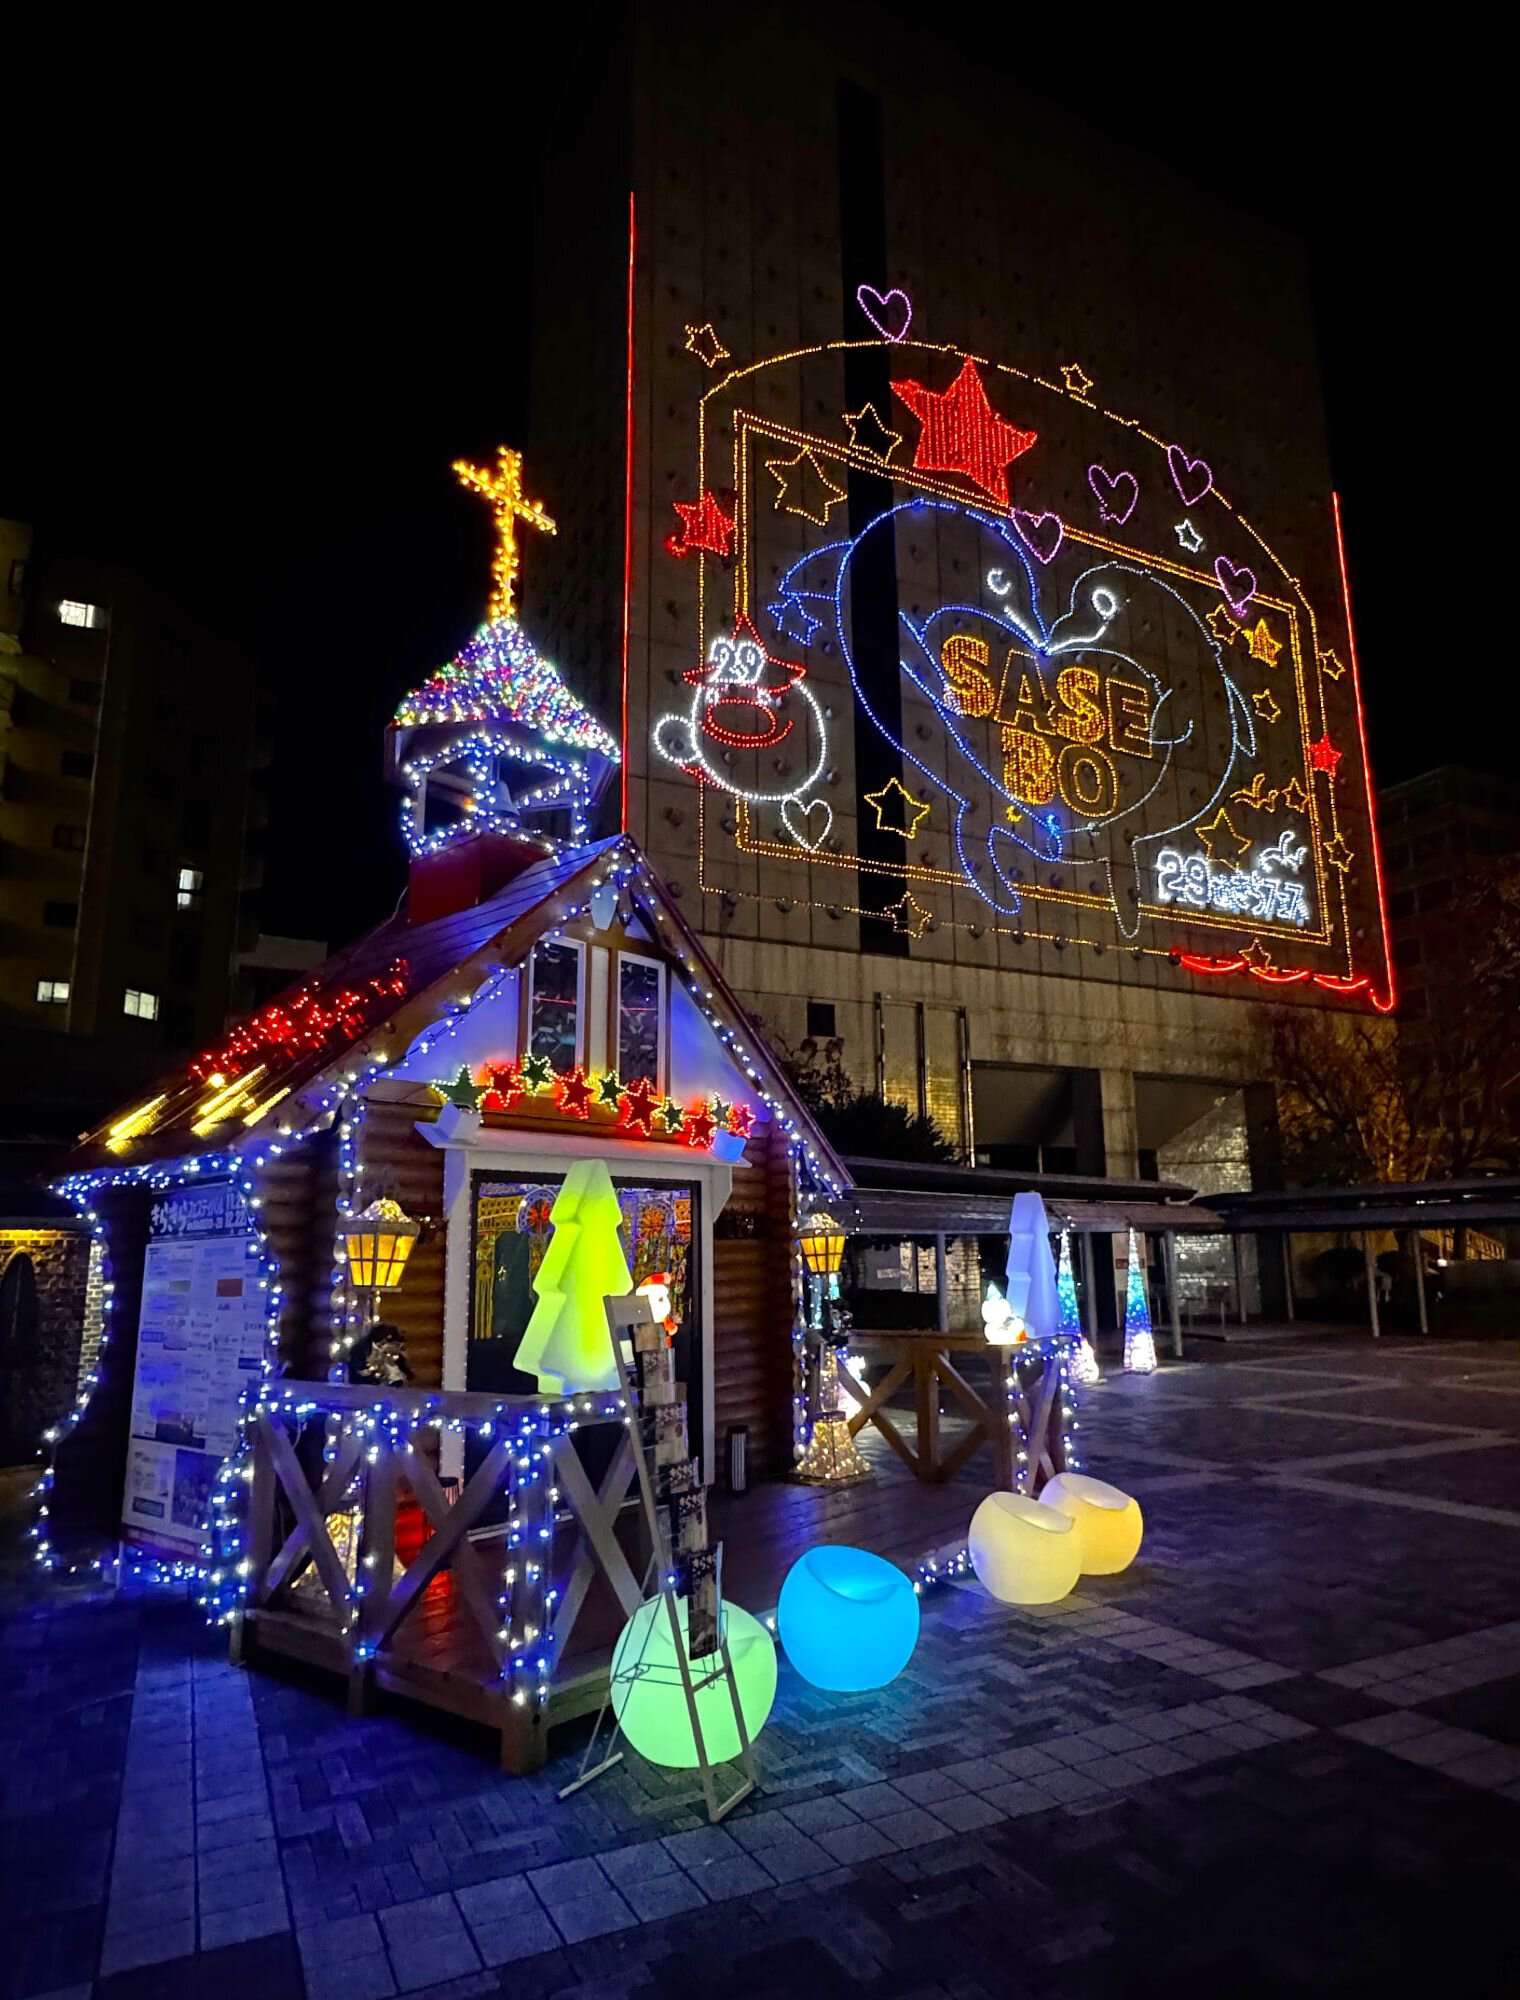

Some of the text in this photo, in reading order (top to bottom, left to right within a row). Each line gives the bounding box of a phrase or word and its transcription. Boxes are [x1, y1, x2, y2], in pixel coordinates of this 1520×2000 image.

[708, 636, 766, 684] 29
[940, 633, 1153, 759] SASE
[1002, 725, 1119, 818] BO
